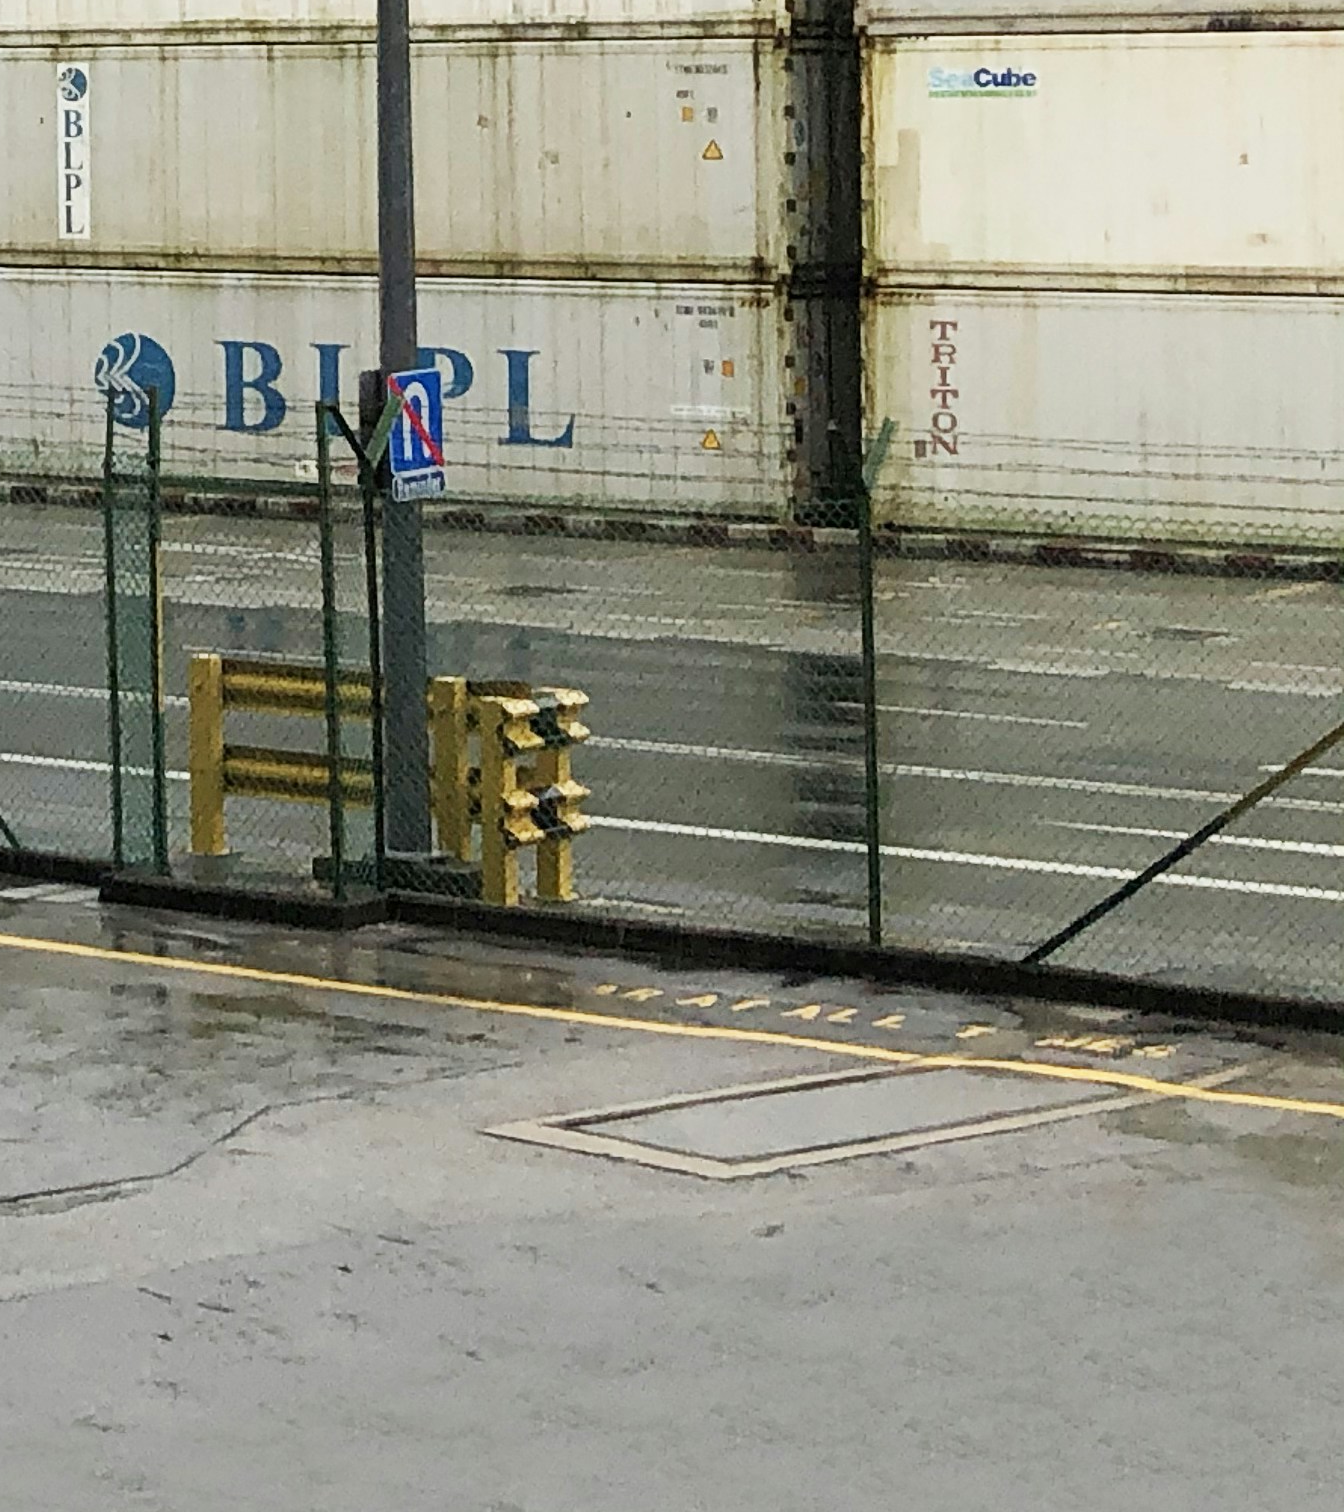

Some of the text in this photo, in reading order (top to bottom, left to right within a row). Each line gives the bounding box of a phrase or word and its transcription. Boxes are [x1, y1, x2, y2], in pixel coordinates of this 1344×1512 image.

[928, 67, 1038, 88] SeaCube
[63, 108, 84, 234] BLPL
[929, 319, 960, 456] TRITON
